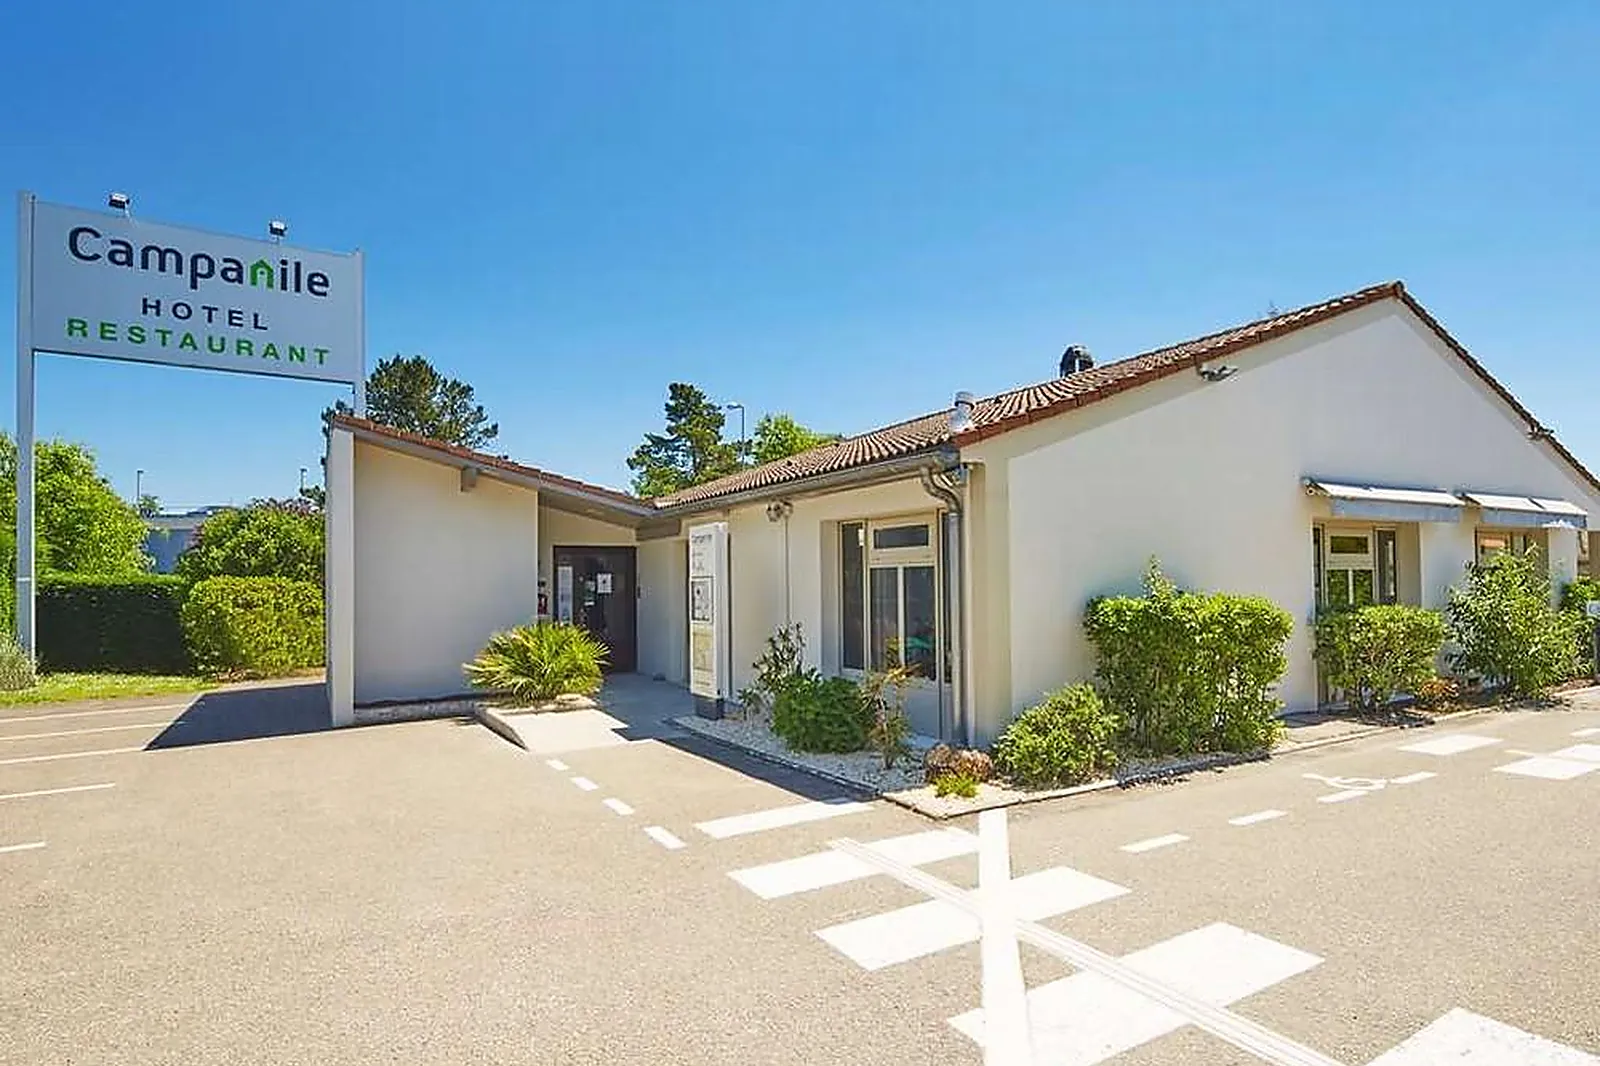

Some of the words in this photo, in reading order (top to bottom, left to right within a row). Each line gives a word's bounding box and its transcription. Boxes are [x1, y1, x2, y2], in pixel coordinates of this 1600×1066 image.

[68, 226, 330, 297] Campanile
[142, 298, 268, 331] HOTEL
[66, 318, 330, 365] RESTAURANT
